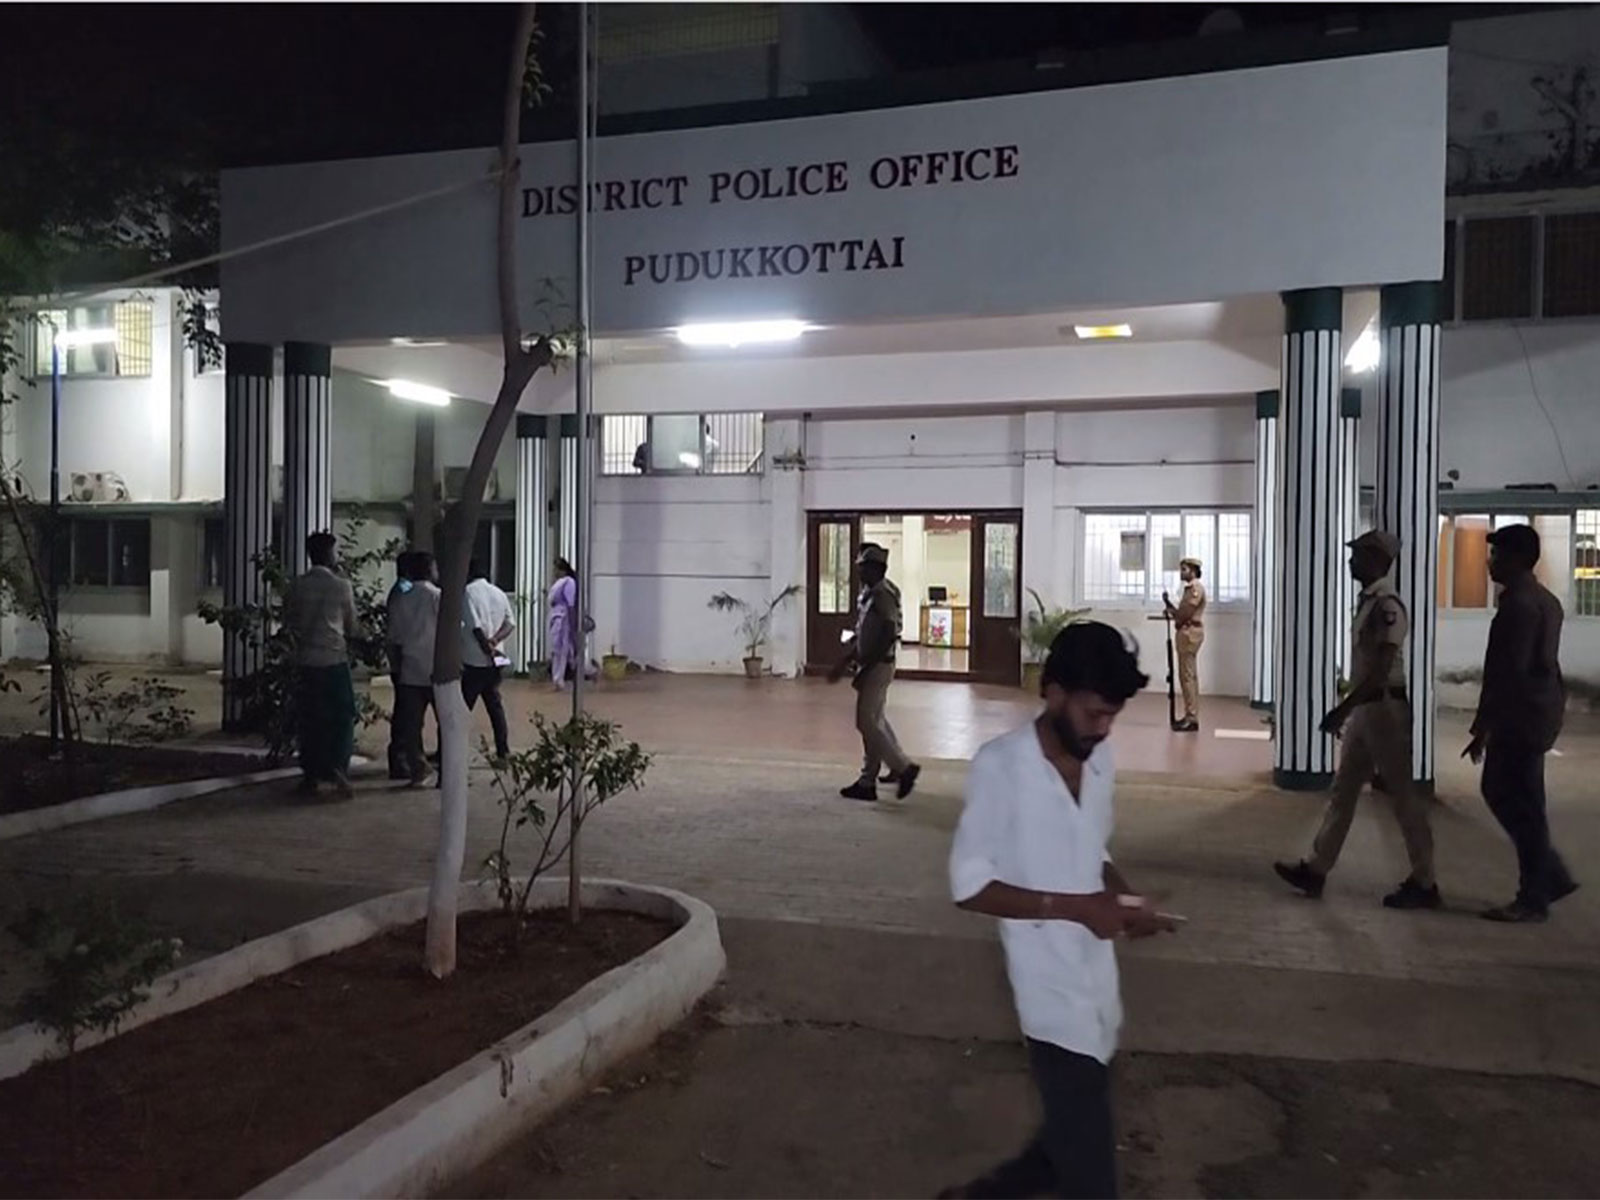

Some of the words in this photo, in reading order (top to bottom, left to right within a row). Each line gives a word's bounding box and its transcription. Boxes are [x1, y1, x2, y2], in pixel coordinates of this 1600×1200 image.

[709, 162, 848, 203] POLICE
[870, 145, 1019, 189] OFFICE
[624, 236, 905, 285] PUDUKKOTTAI
